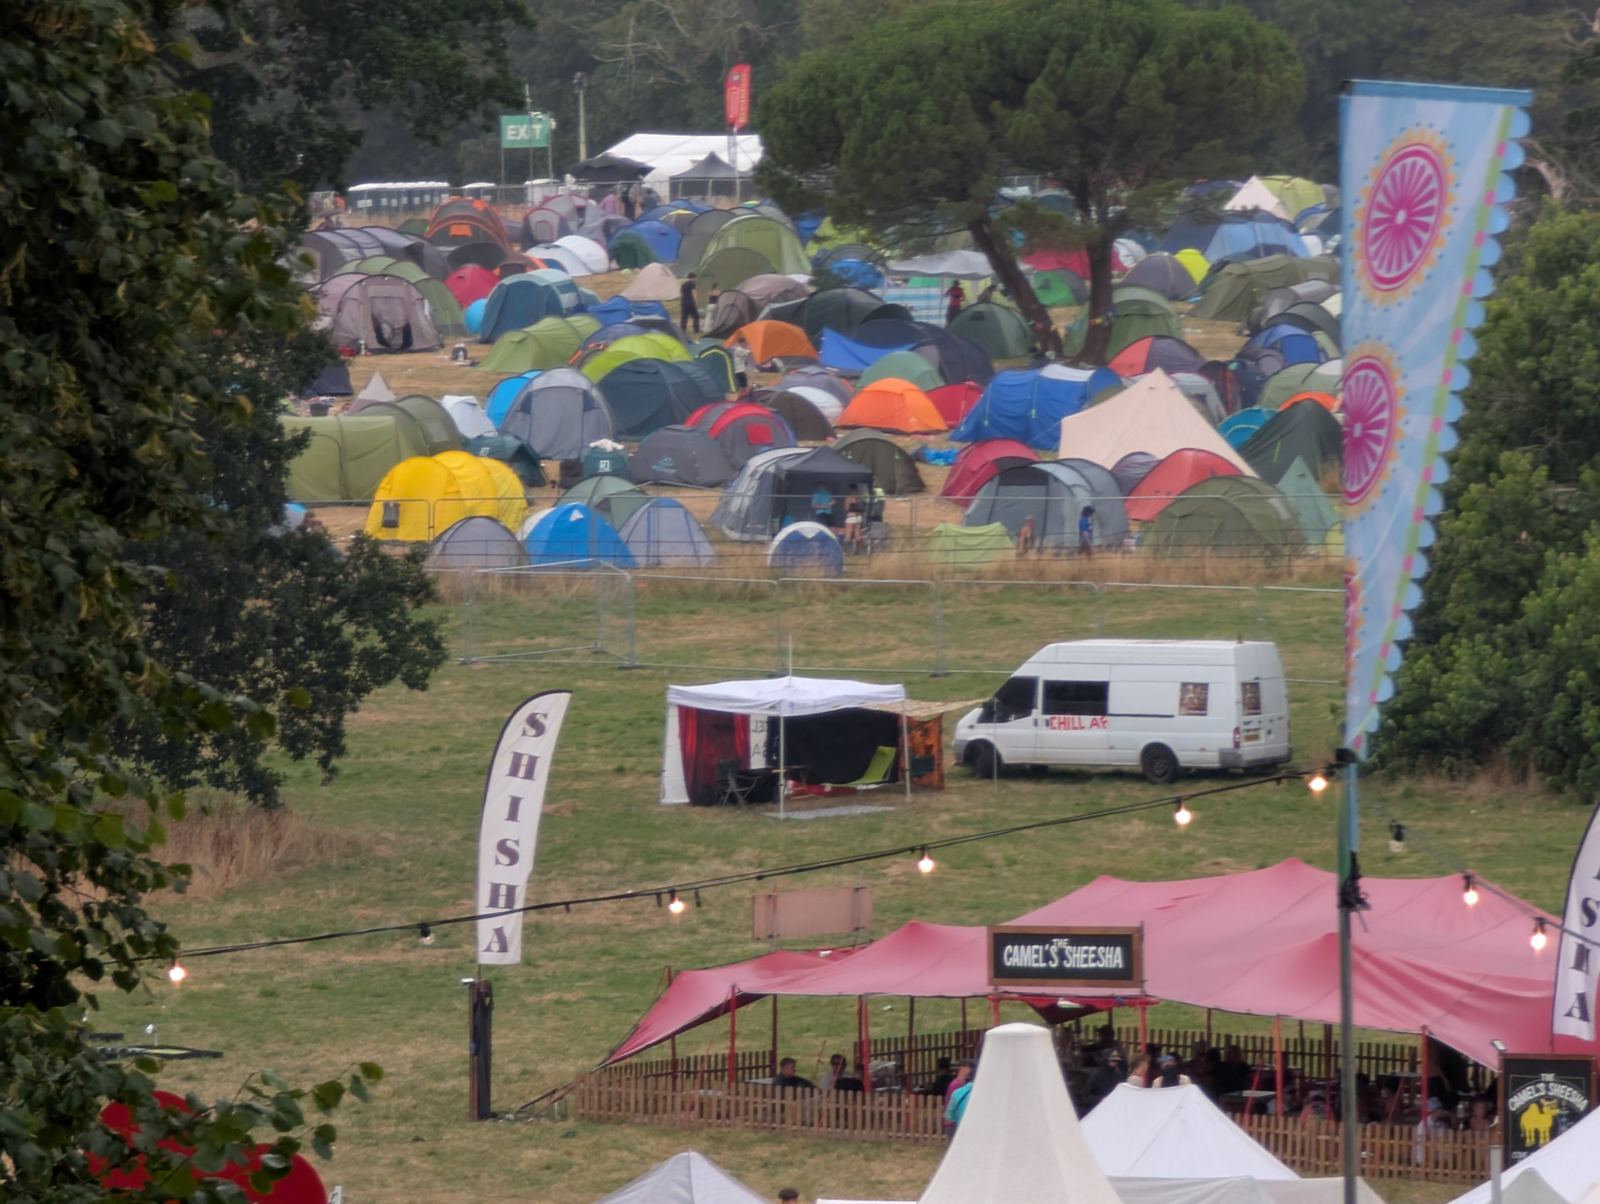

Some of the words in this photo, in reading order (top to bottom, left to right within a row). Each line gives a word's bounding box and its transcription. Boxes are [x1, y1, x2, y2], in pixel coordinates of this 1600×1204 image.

[507, 124, 543, 140] EXT
[1050, 715, 1086, 731] CHILL
[482, 712, 550, 954] SHISHA
[1003, 944, 1059, 968] CAMEL'S
[1063, 945, 1123, 969] SHEESHA
[1547, 1082, 1588, 1112] SHEESHA
